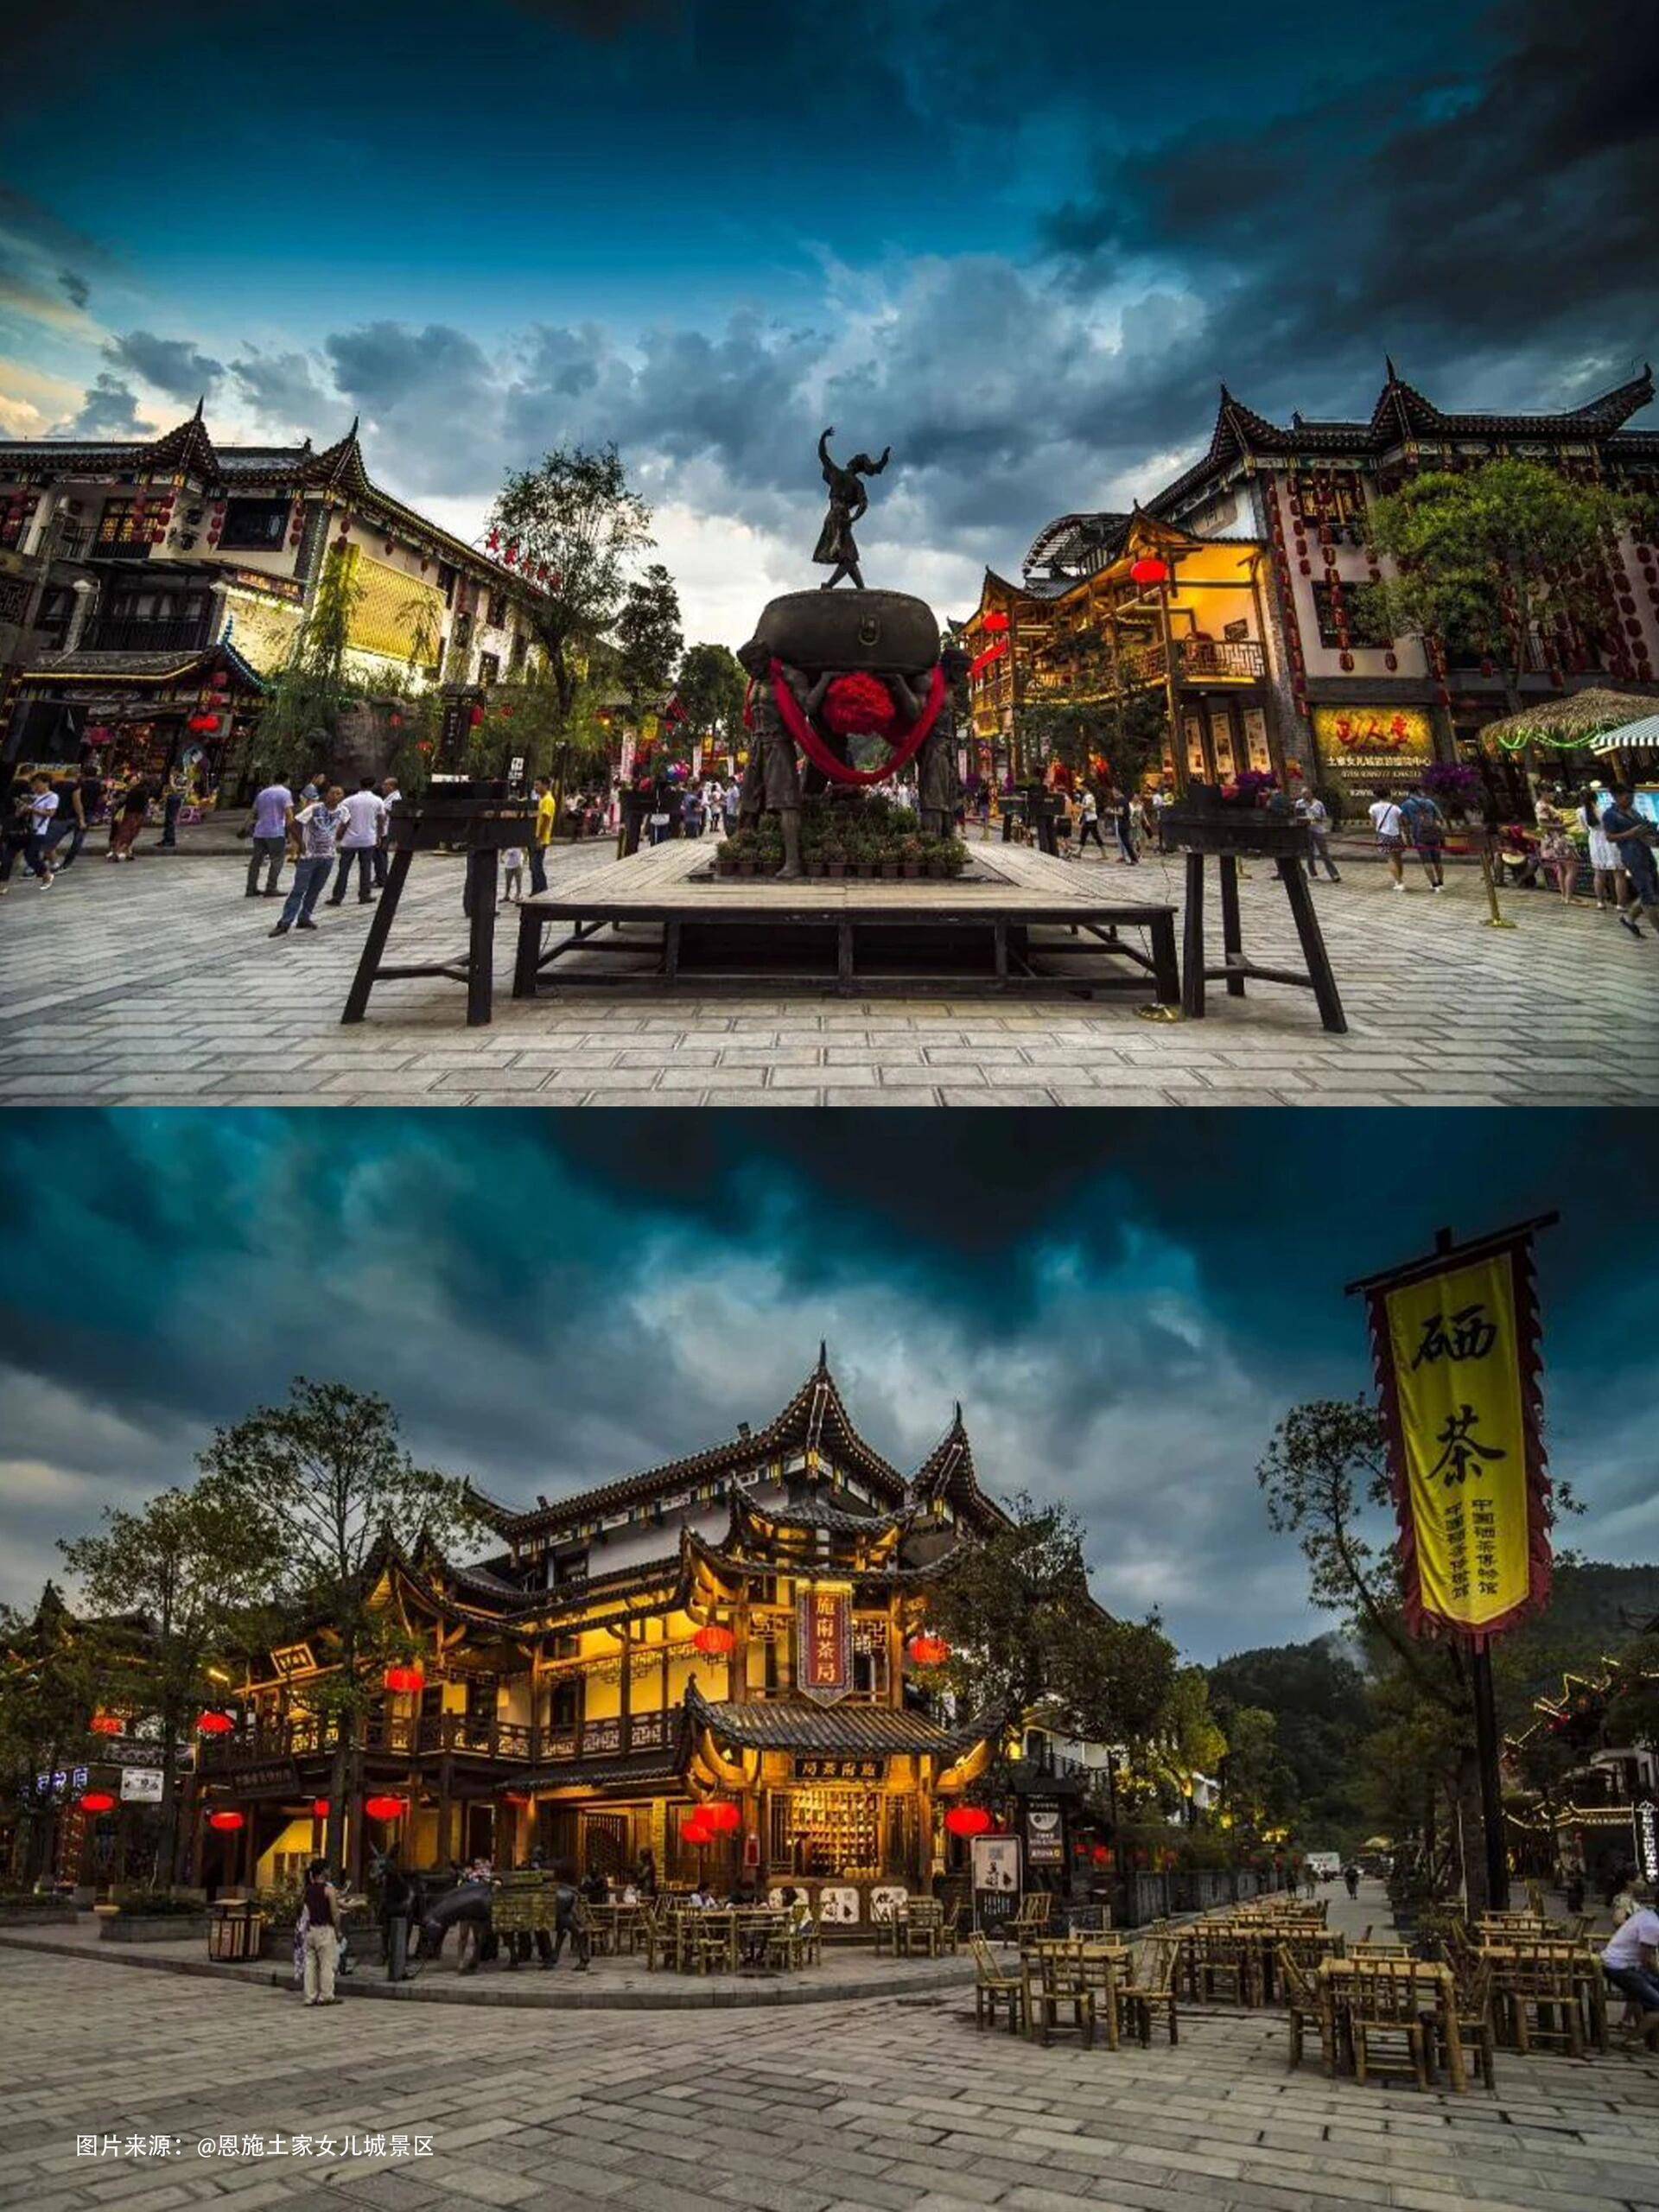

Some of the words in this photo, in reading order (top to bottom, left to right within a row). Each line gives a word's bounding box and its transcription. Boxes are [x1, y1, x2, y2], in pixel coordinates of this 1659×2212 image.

[1410, 1303, 1507, 1488] 硒茶
[816, 1596, 836, 1683] 施南茶局
